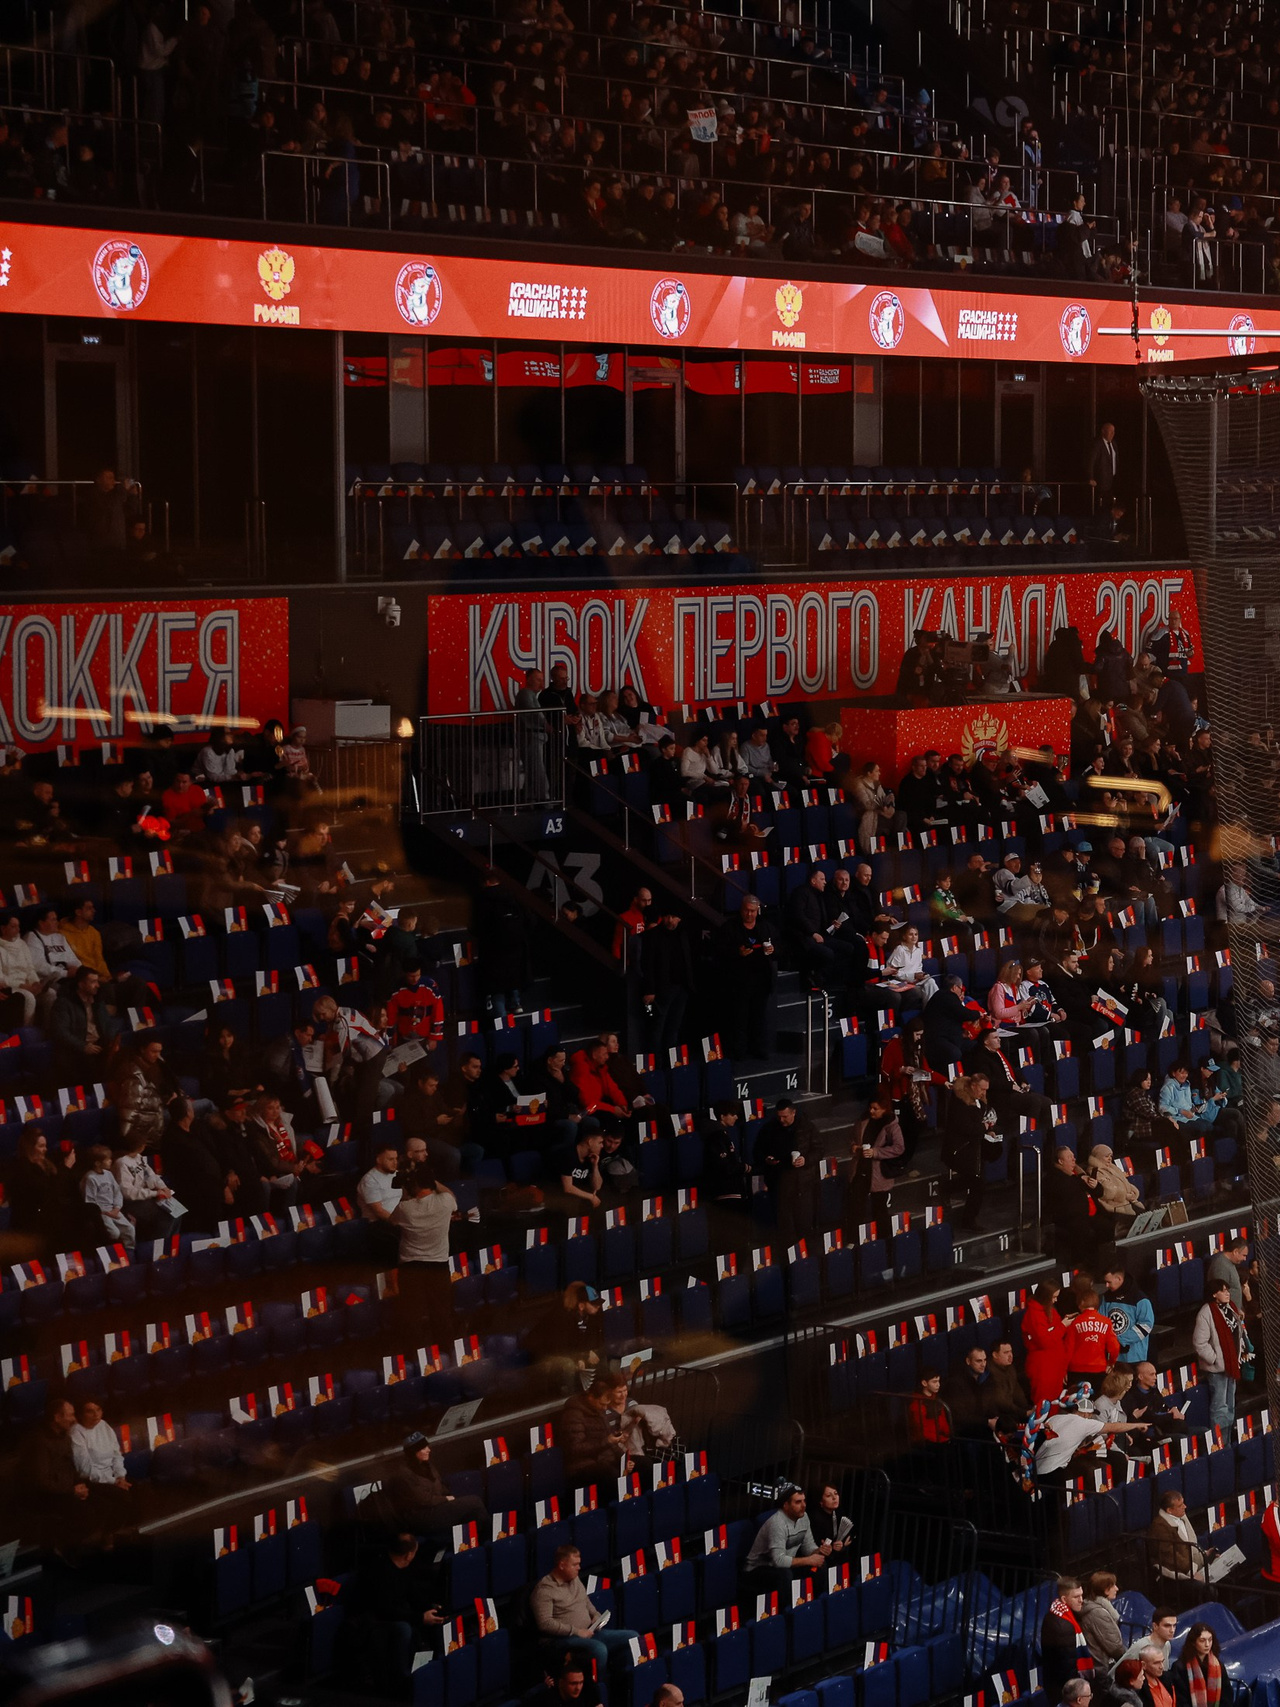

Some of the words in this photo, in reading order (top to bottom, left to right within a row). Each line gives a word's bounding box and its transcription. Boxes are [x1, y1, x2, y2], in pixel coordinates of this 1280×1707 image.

[510, 282, 562, 300] КРАСНАЯ
[254, 303, 300, 325] РОССИЯ
[508, 298, 560, 319] МАШИНА
[959, 309, 998, 325] КРАСНАЯ
[772, 330, 806, 348] РОССИЯ
[957, 323, 997, 340] МАШИНА
[468, 597, 649, 713] КУБОК
[674, 589, 880, 702] ПЕРВОГО
[545, 817, 563, 835] A3
[526, 850, 605, 918] A3
[786, 1074, 798, 1090] 14
[737, 1083, 749, 1099] 14
[999, 1235, 1009, 1251] 11
[953, 1247, 963, 1264] 11
[1075, 1320, 1109, 1335] RUSSIA
